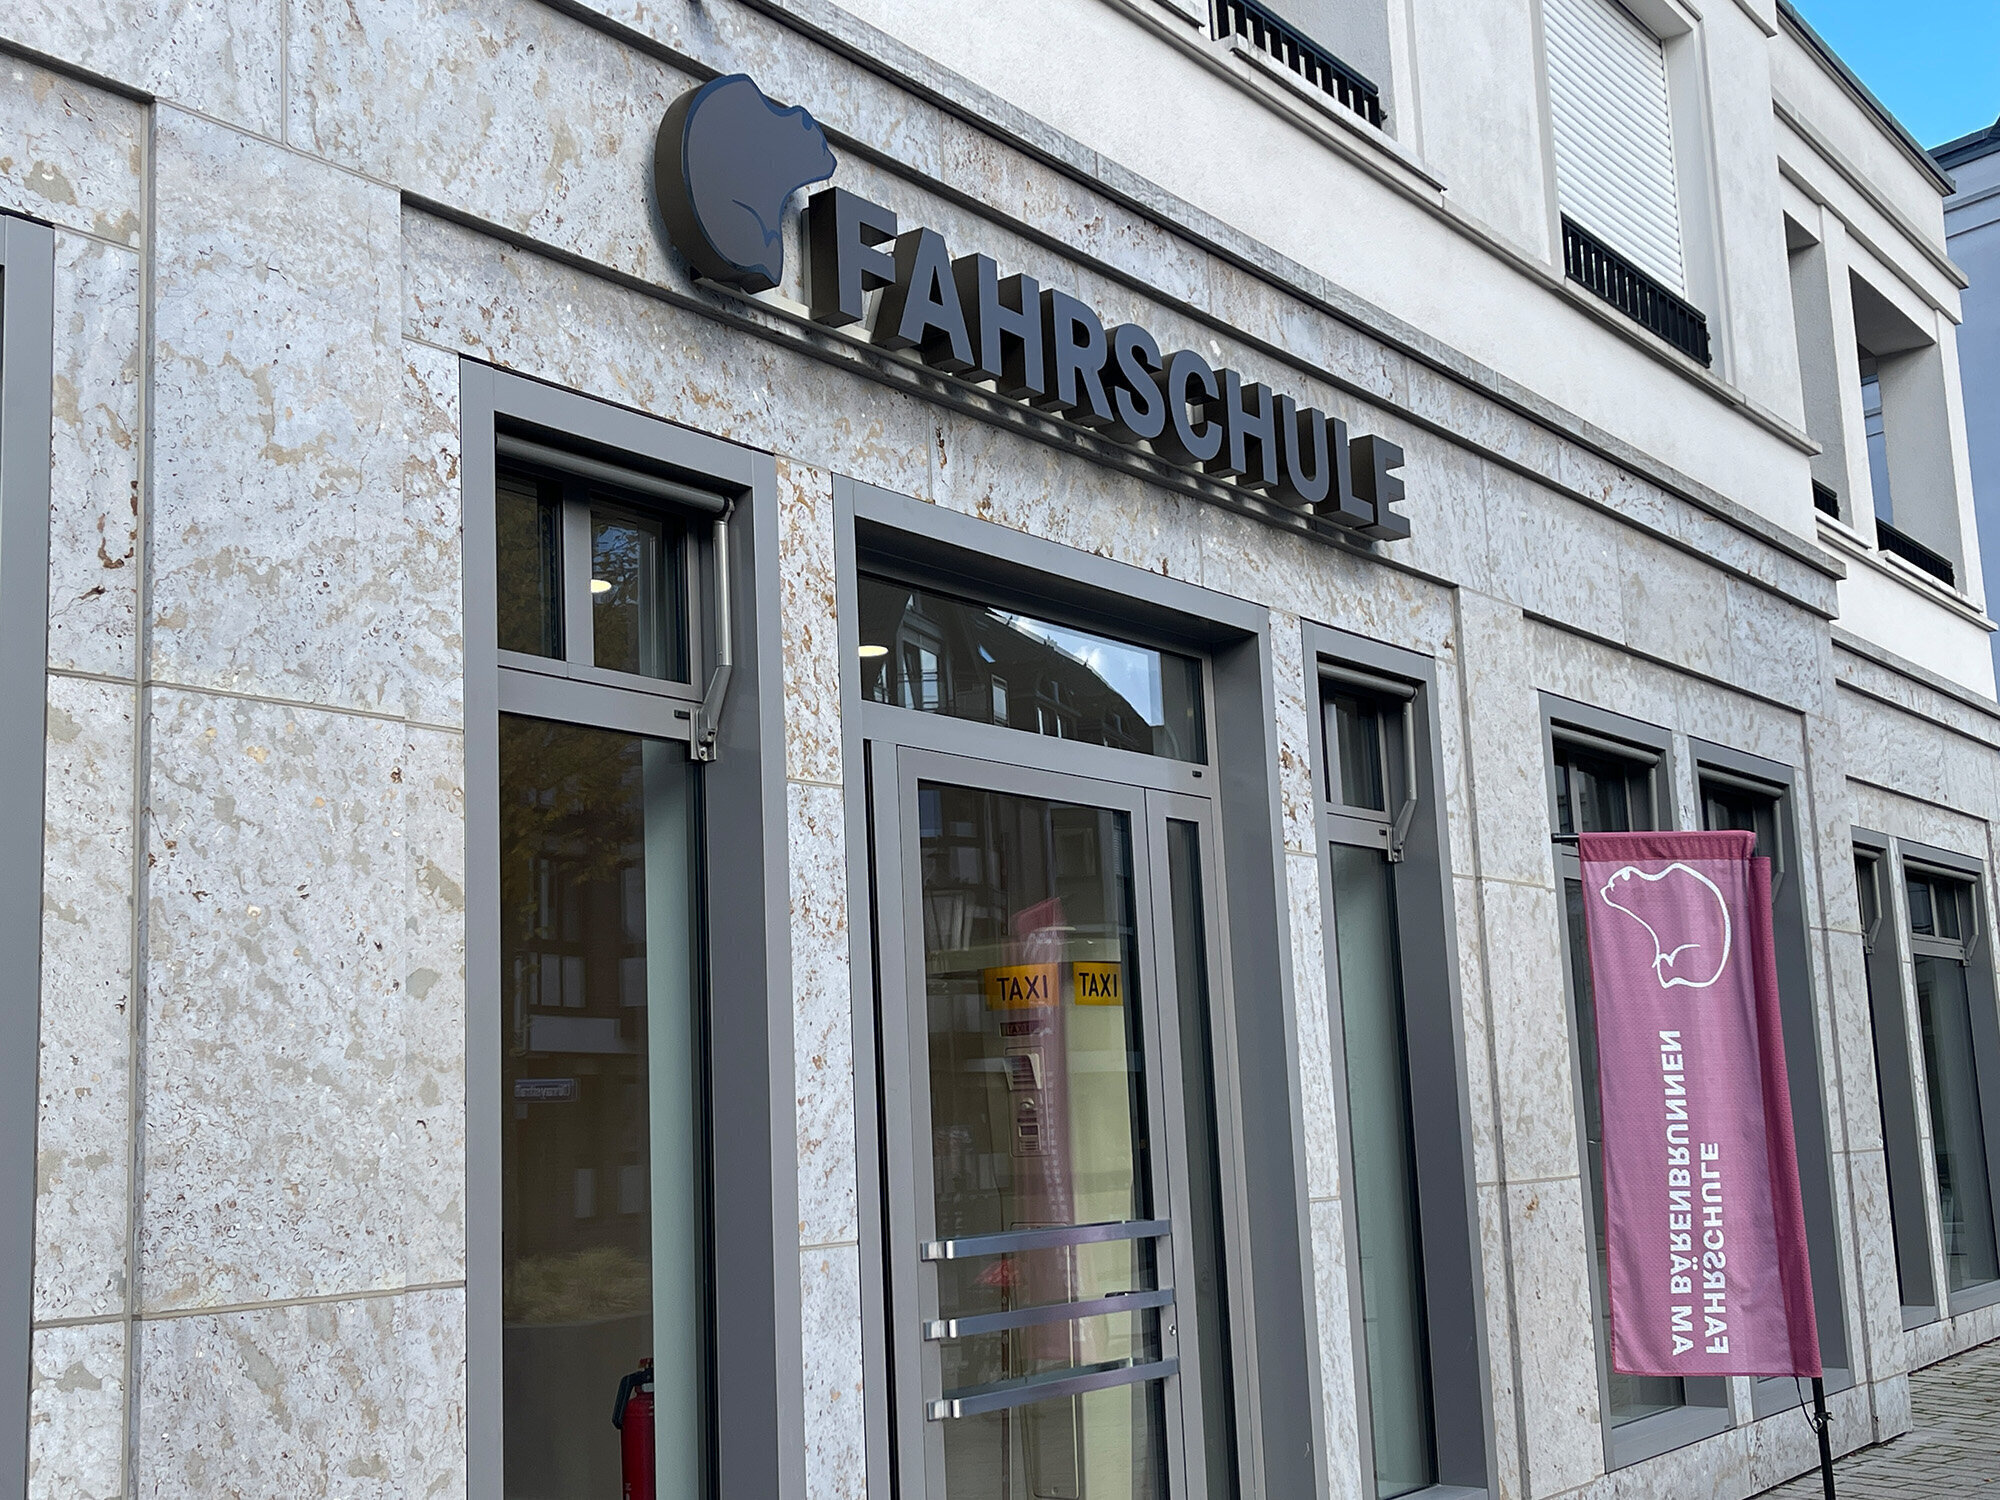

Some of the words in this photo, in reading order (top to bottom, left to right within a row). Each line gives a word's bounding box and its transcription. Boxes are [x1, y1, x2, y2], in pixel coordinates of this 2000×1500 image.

[810, 186, 1411, 541] FAHRSCHULE
[996, 974, 1048, 1001] TAXI
[1078, 972, 1118, 998] TAXI
